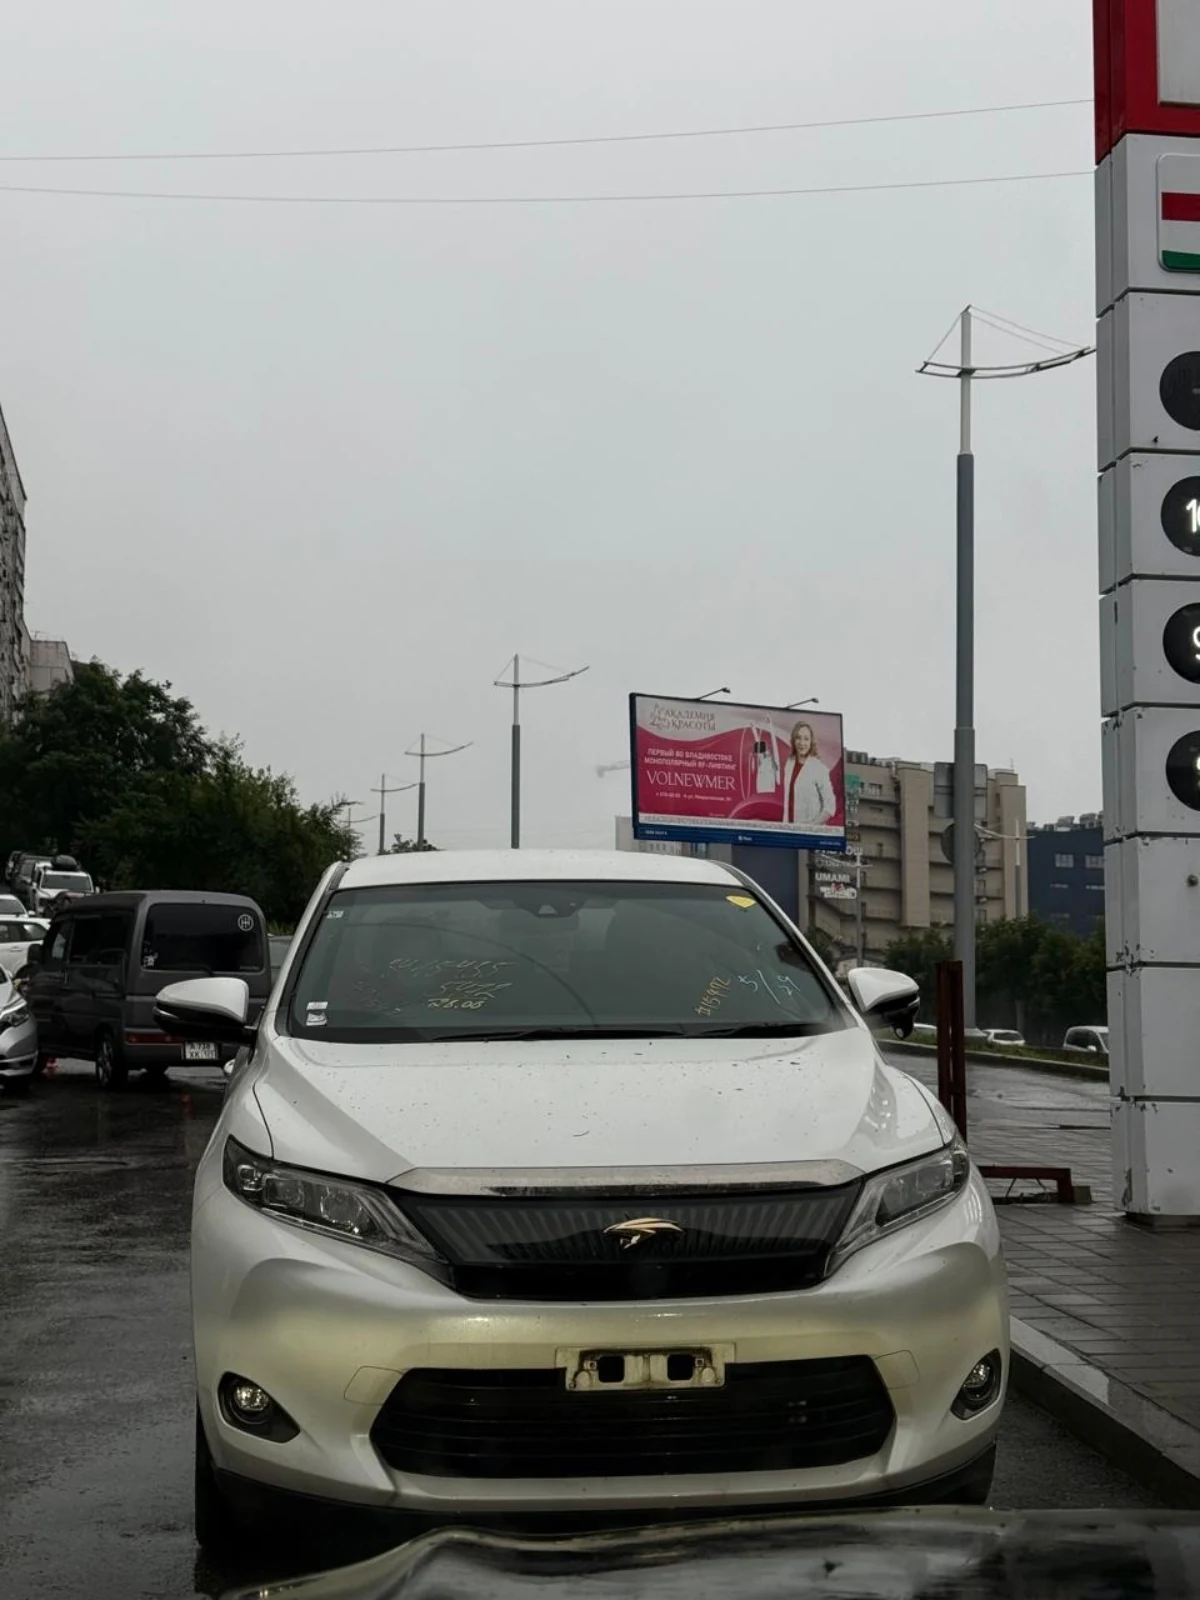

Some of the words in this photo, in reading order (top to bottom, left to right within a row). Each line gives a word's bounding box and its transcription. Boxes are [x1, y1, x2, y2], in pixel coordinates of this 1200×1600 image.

[664, 709, 715, 721] АКАДЕМИЯ
[671, 719, 716, 731] КРАСОТЫ
[647, 748, 674, 757] ПЕРВЫЙ
[685, 751, 733, 761] ВЛАДИВОСТОКЕ
[644, 756, 697, 767] МОНОПОЛЯРНЫЙ
[646, 770, 736, 790] VOLNEWMER
[815, 872, 850, 882] UMAMI
